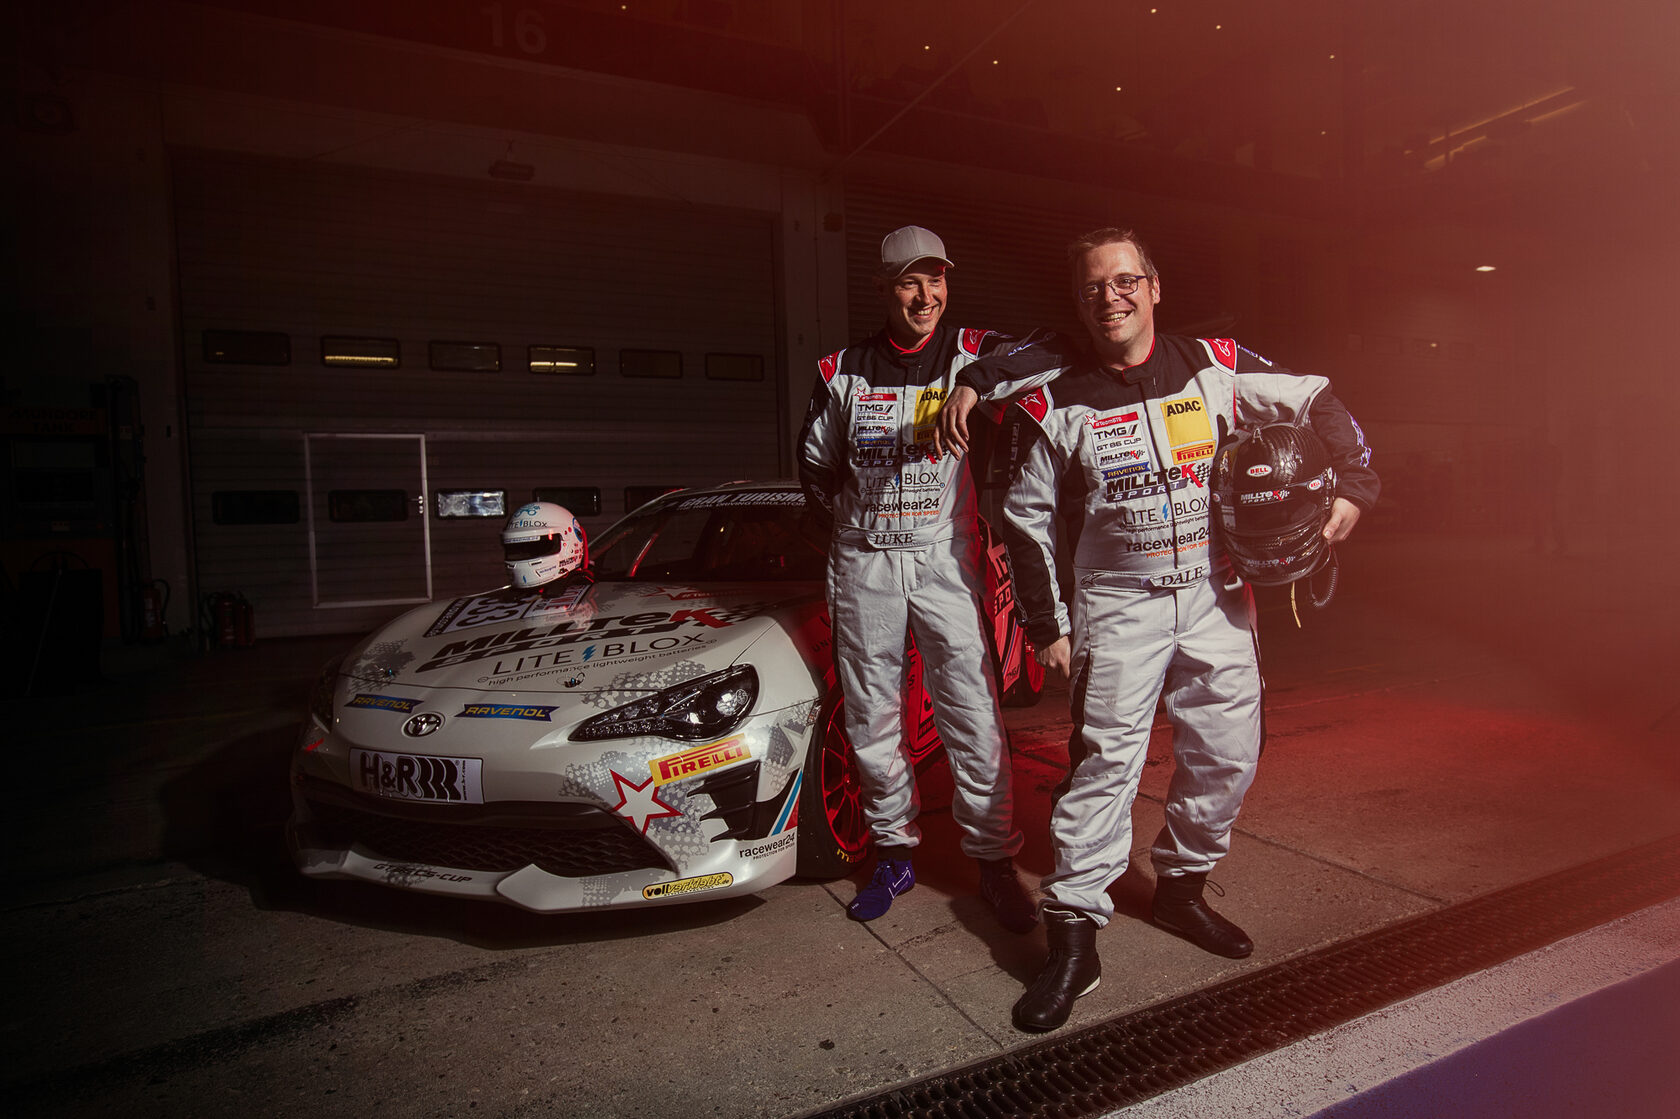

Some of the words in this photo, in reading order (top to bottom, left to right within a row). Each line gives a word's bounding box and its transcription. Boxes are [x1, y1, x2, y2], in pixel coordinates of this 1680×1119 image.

[480, 1, 547, 54] 16
[858, 404, 884, 412] TMG
[1167, 400, 1201, 417] ADAC
[32, 423, 75, 433] TANK
[1093, 427, 1127, 440] TMG
[1123, 437, 1142, 446] CUP
[1177, 444, 1214, 461] PIRELLI
[862, 456, 915, 467] SPOT
[904, 471, 940, 485] BLOX
[1107, 464, 1147, 478] RAVENOL
[1250, 467, 1269, 475] BELL
[1113, 481, 1180, 499] SPORT
[678, 494, 733, 511] GRAN
[865, 498, 940, 513] racewear24
[1122, 508, 1158, 525] LITE
[1174, 496, 1209, 517] BLOX
[523, 520, 548, 528] BLOX
[874, 533, 914, 545] LUKE
[1126, 526, 1210, 552] racewear24
[1161, 567, 1203, 586] DALE
[432, 625, 657, 667] SPORT
[493, 649, 575, 675] LITE
[603, 633, 705, 658] BLOX
[488, 676, 514, 687] high
[592, 654, 657, 669] lightweight
[657, 644, 707, 658] batteries
[353, 696, 412, 711] RAVENOL
[465, 706, 546, 718] RAVENOL
[658, 738, 744, 781] PIRELLI
[739, 832, 796, 859] racewear24
